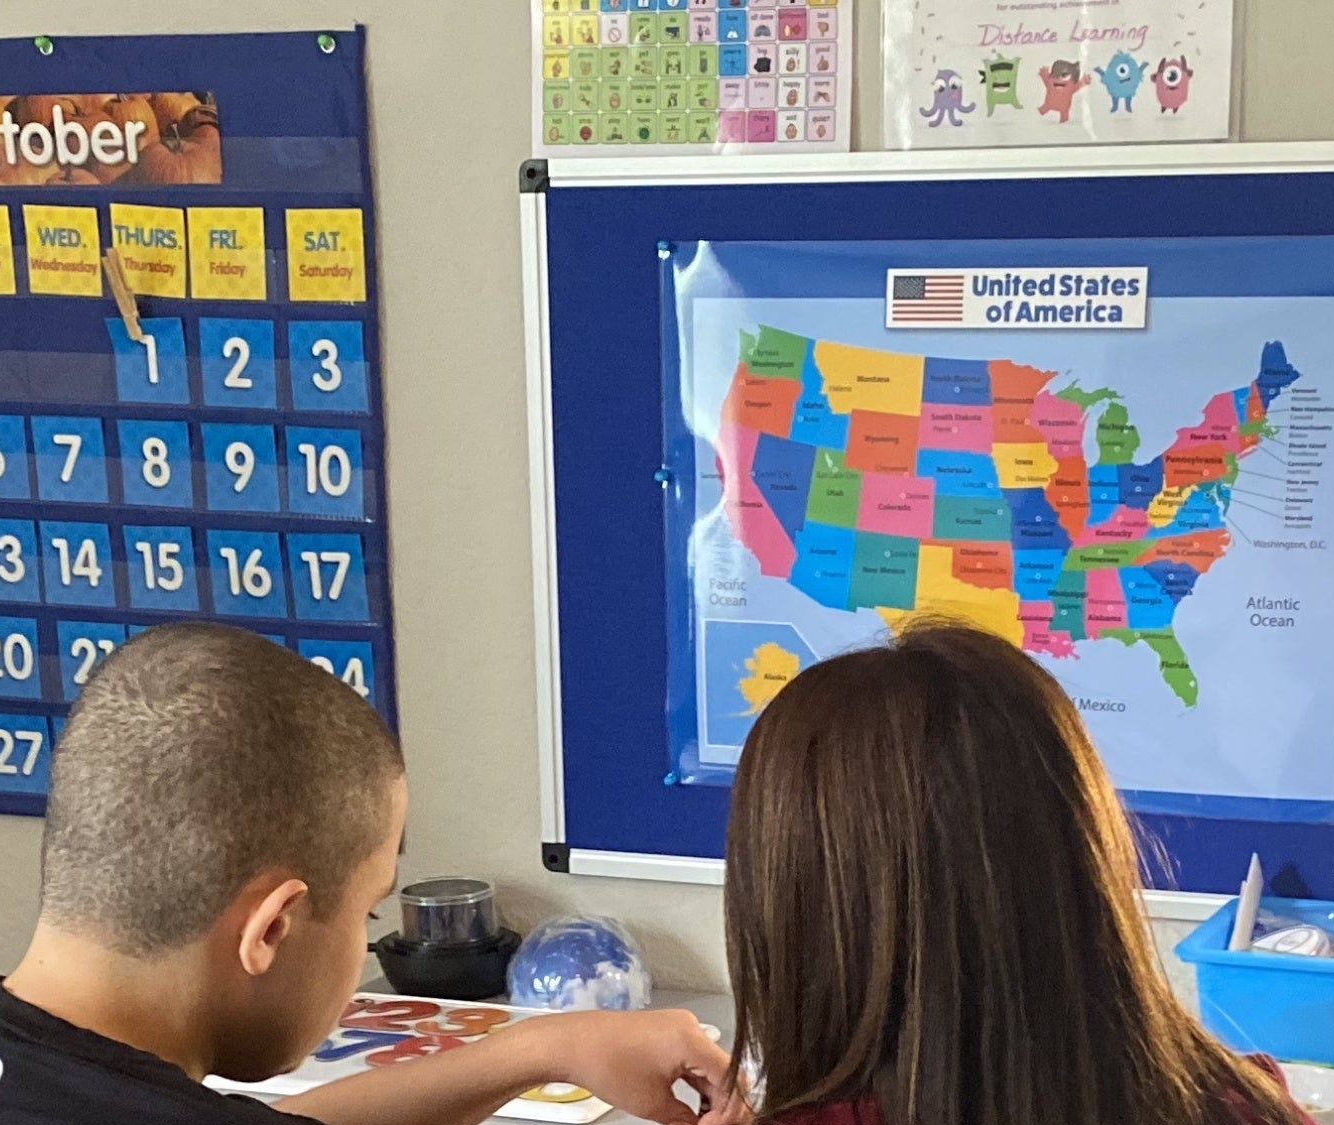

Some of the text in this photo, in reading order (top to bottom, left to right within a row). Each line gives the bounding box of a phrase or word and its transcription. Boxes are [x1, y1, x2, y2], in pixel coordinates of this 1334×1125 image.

[977, 20, 1150, 51] Distance Learning
[36, 227, 88, 248] WED.
[114, 225, 183, 250] THURS.
[208, 229, 244, 250] FRI.
[303, 231, 346, 251] SAT.
[30, 257, 98, 275] Wednesday
[124, 257, 176, 278] Thursday
[209, 263, 246, 278] Friday
[299, 264, 354, 280] Saturday
[972, 273, 1140, 298] United States
[985, 299, 1123, 323] of America
[138, 333, 342, 393] 1 2 3
[1190, 432, 1228, 441] New York
[52, 433, 82, 482] 7
[141, 436, 171, 489] 8
[224, 441, 255, 493] 9
[298, 442, 352, 498] 10
[51, 537, 103, 588] 14
[135, 540, 184, 592] 15
[220, 546, 272, 599] 16
[300, 550, 352, 601] 17
[709, 577, 747, 592] Pacific
[709, 593, 747, 607] Ocean
[1246, 596, 1300, 612] Atlantic
[1249, 614, 1295, 628] Ocean
[1078, 698, 1126, 713] Mexico
